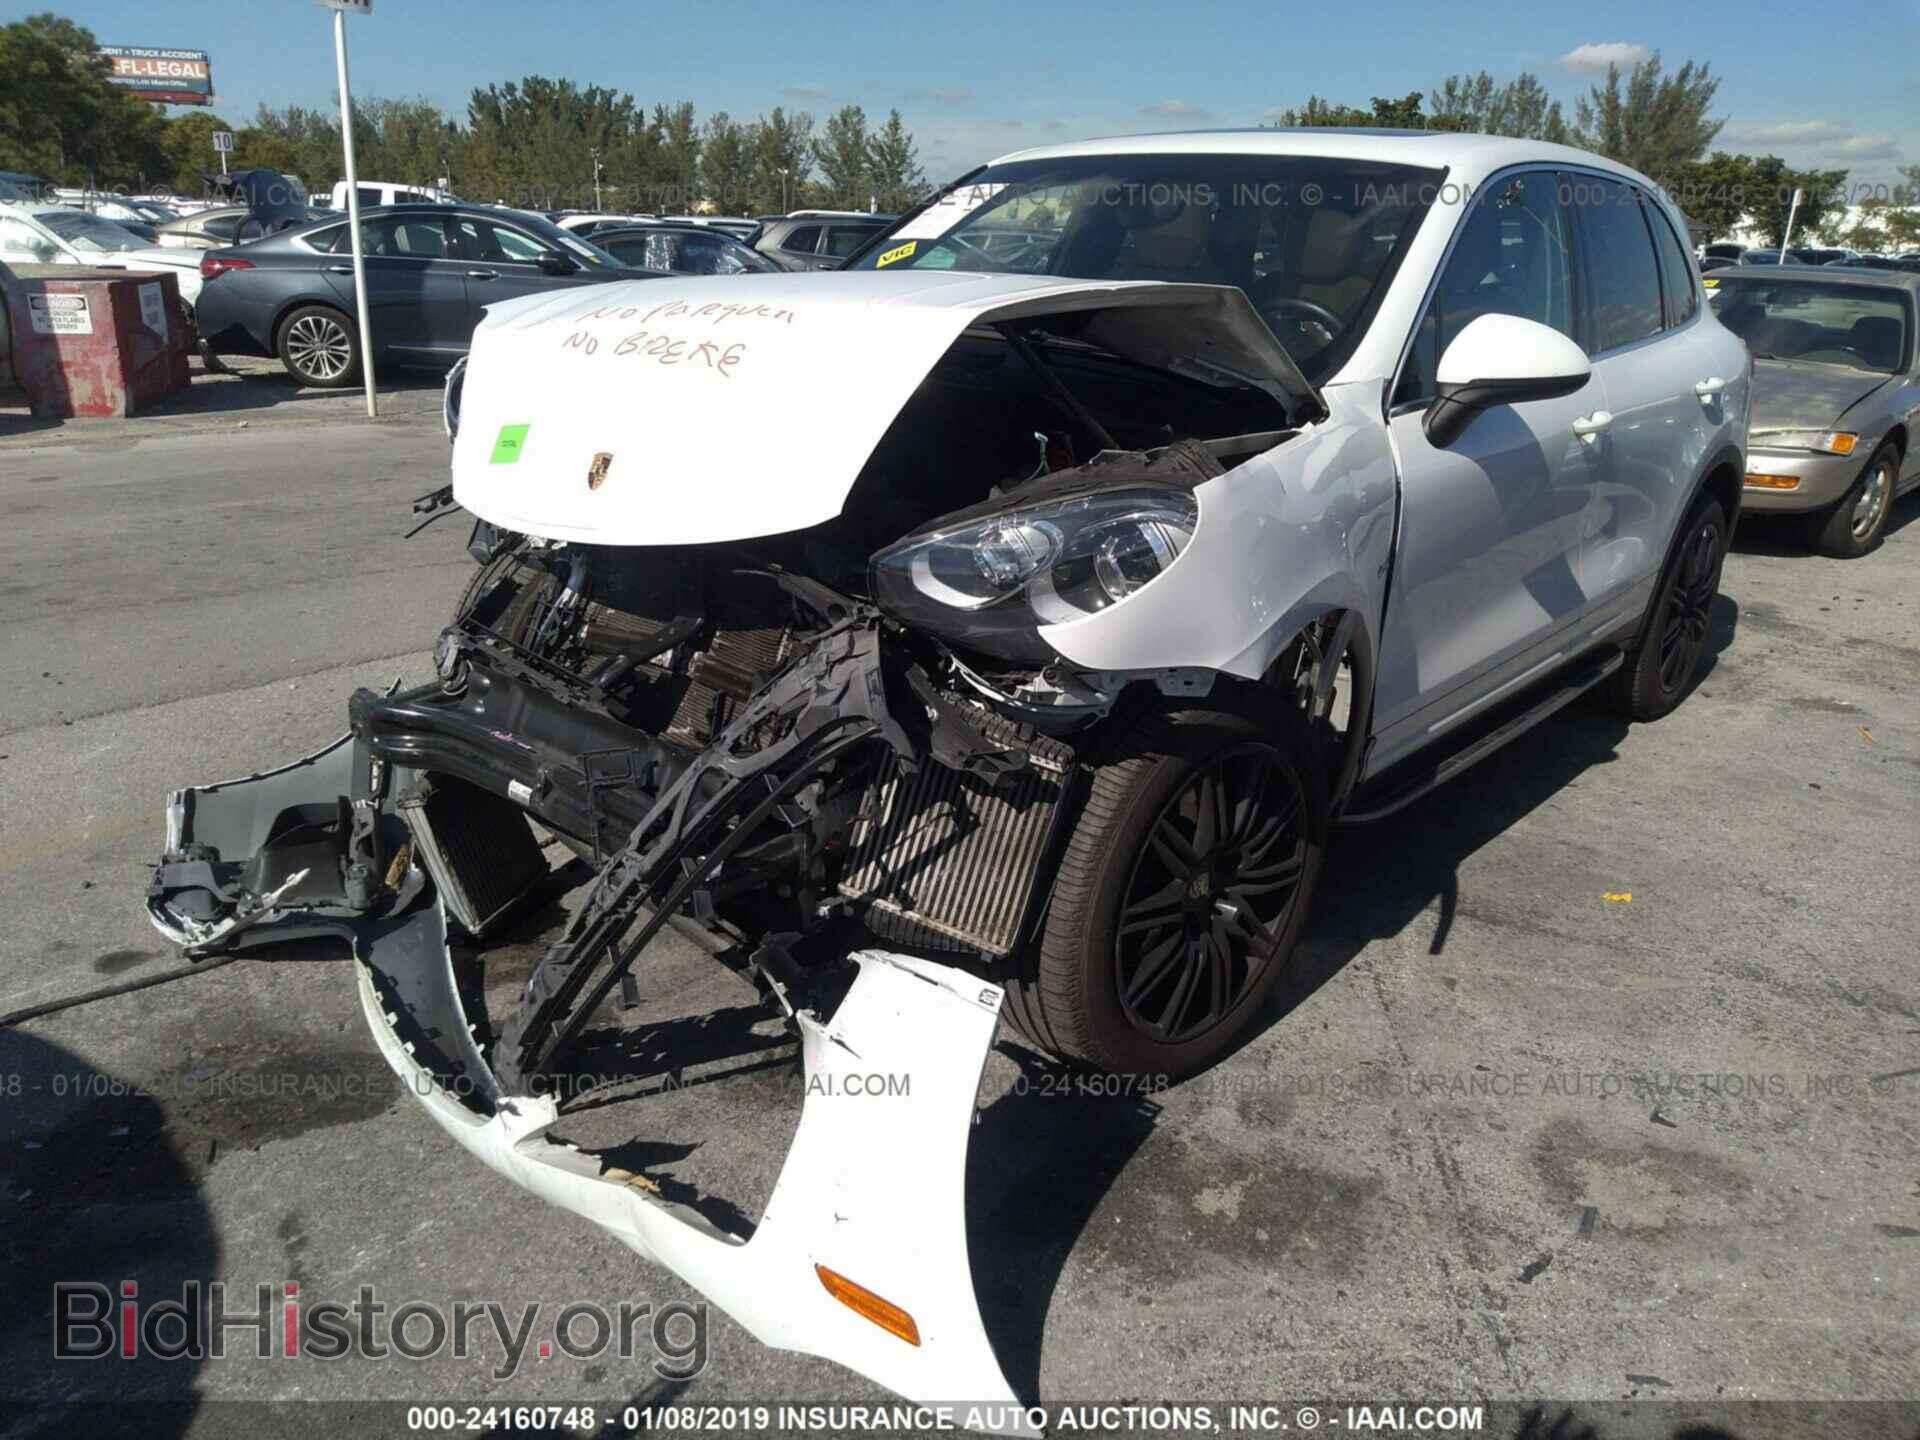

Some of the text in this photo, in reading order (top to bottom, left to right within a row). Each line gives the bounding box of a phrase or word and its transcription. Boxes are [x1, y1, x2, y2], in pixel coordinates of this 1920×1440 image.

[131, 49, 158, 57] TRUCK
[161, 51, 202, 59] ACCIDENT
[215, 134, 231, 149] 10
[563, 332, 598, 355] NO
